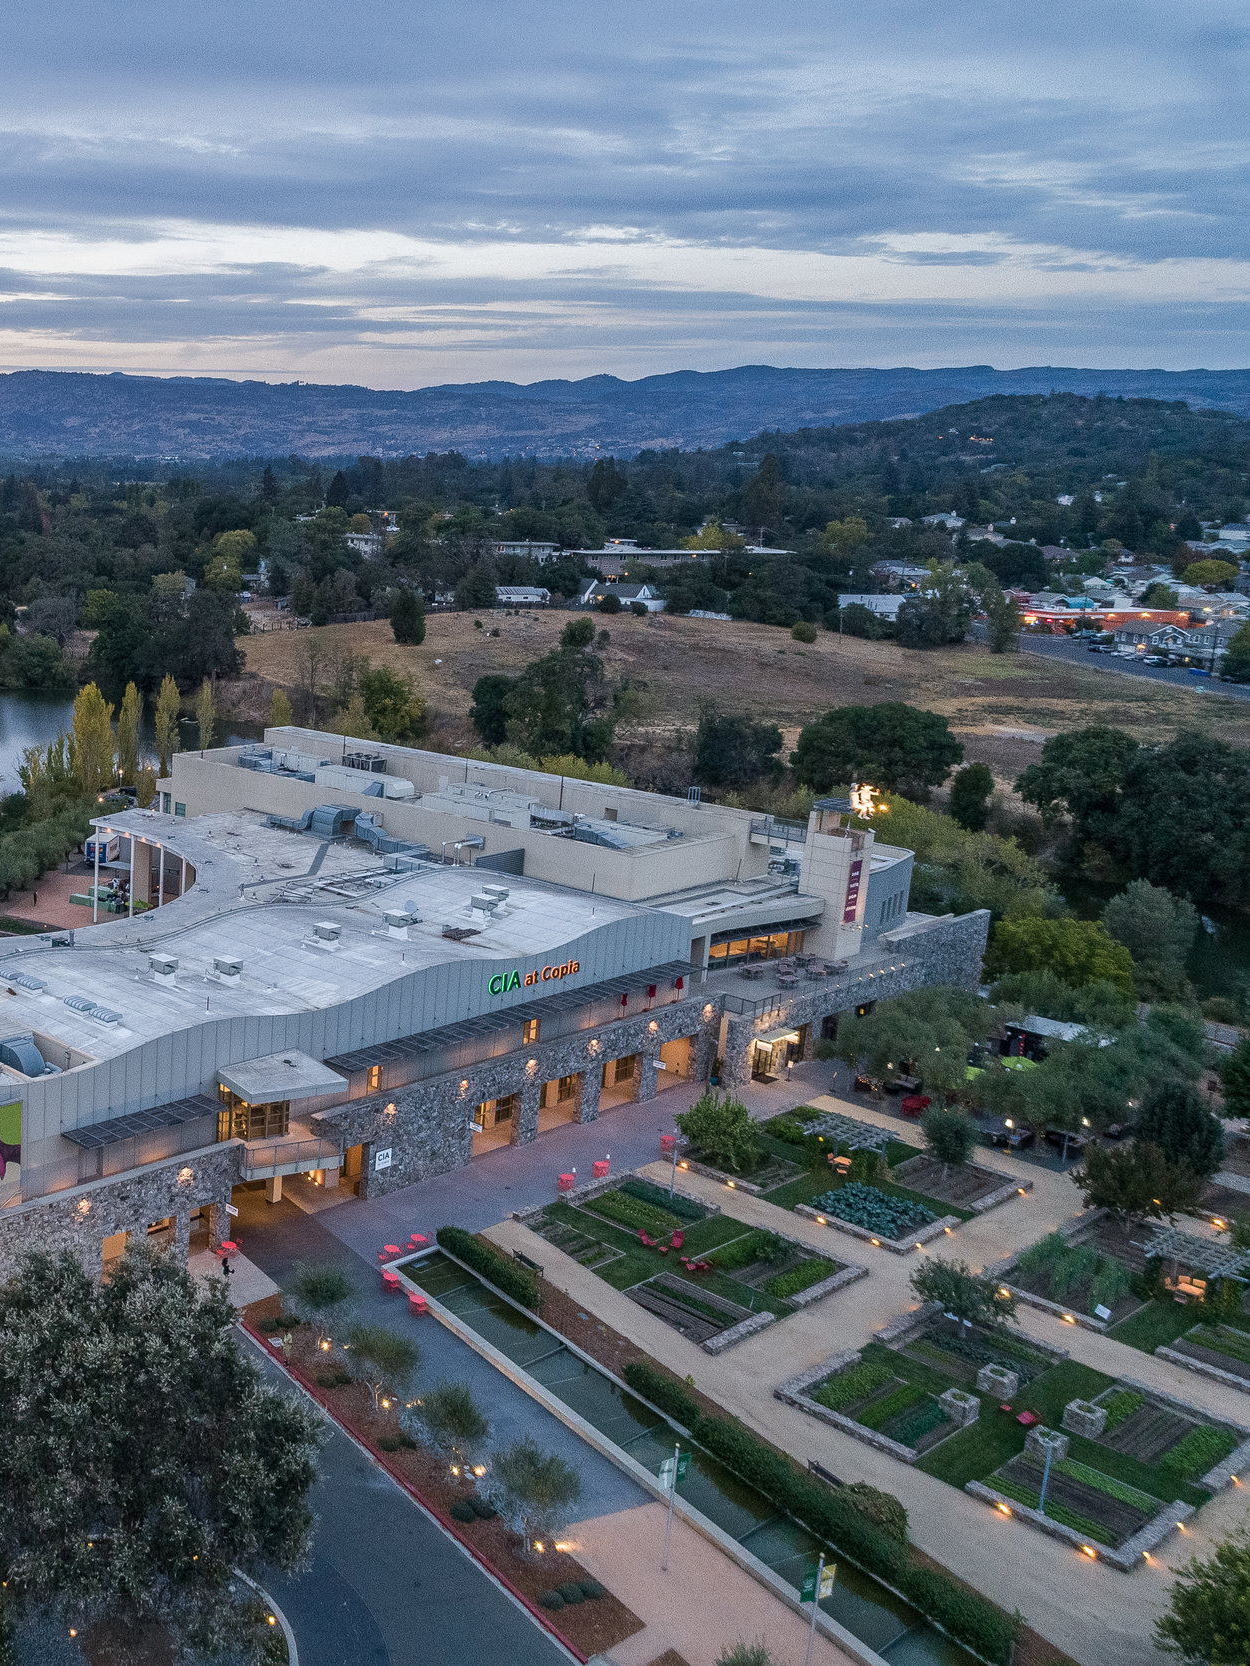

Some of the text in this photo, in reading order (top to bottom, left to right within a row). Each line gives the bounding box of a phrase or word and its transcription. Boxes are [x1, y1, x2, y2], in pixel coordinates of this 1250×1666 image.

[488, 959, 580, 996] CIA at Copia
[377, 1151, 390, 1162] CIA
